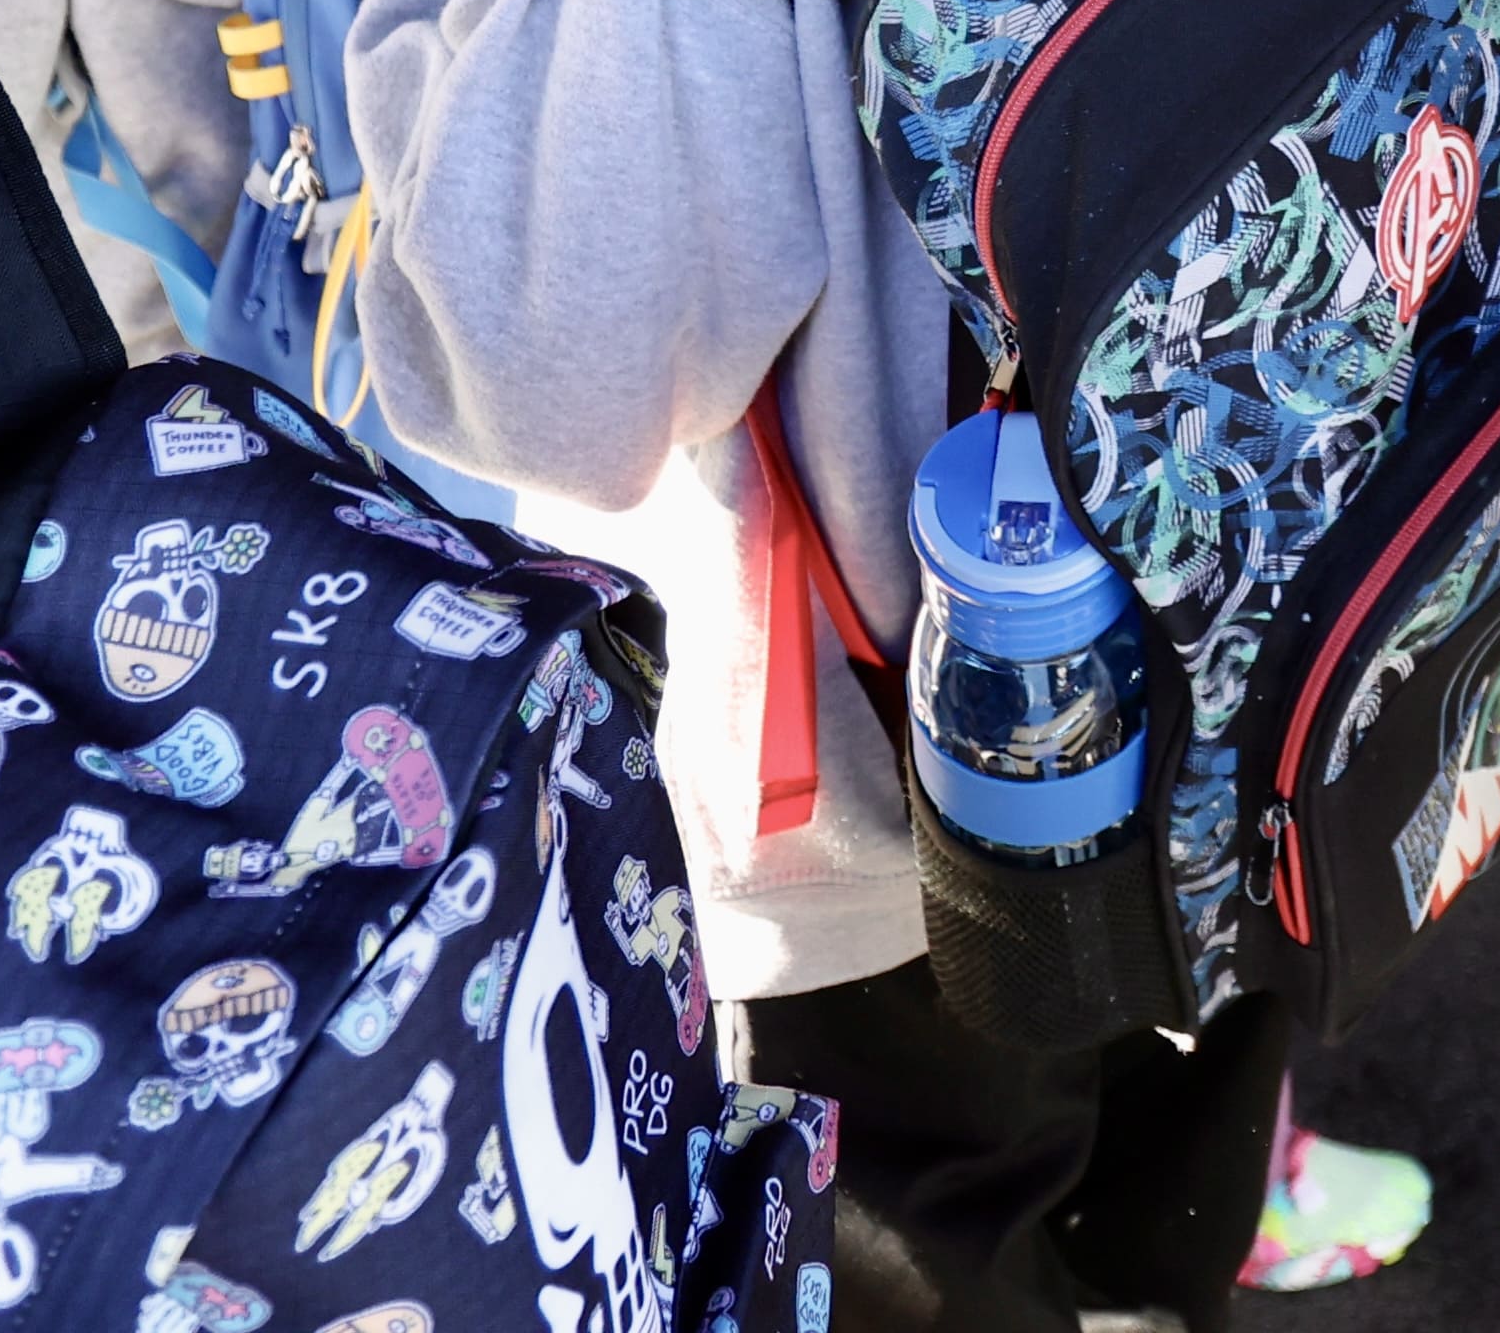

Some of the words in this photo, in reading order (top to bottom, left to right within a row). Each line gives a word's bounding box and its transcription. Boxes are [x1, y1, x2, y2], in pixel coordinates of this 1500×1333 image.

[165, 443, 227, 457] COFFEE
[417, 605, 476, 639] COFFEE
[429, 591, 496, 629] THUNDER
[155, 743, 209, 793] GOOD
[621, 1048, 650, 1157] PRO
[645, 1070, 674, 1136] DG
[764, 1176, 784, 1282] PRO
[774, 1202, 793, 1266] DG
